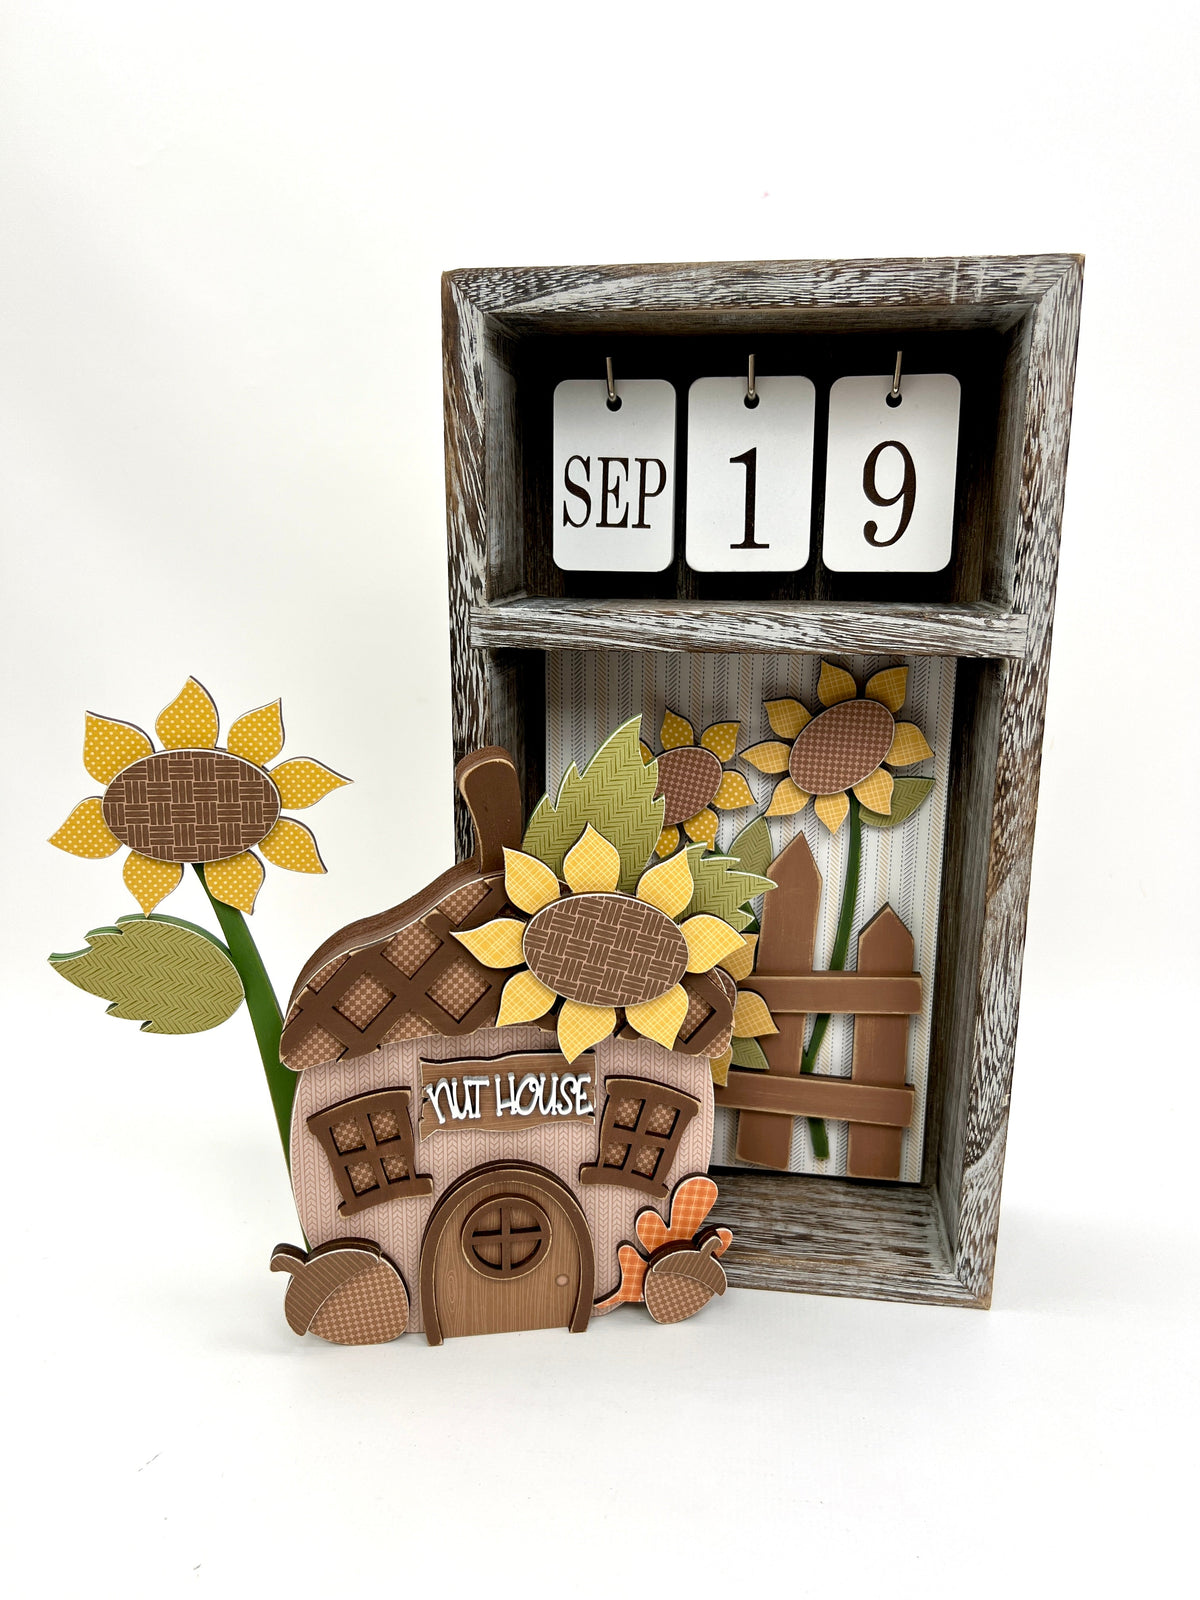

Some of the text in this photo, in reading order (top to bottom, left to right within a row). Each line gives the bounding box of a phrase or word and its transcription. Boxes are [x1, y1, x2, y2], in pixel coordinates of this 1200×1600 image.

[563, 455, 667, 529] SEP
[729, 447, 770, 550] 1
[863, 440, 917, 548] 9
[494, 1072, 594, 1117] HOUSE
